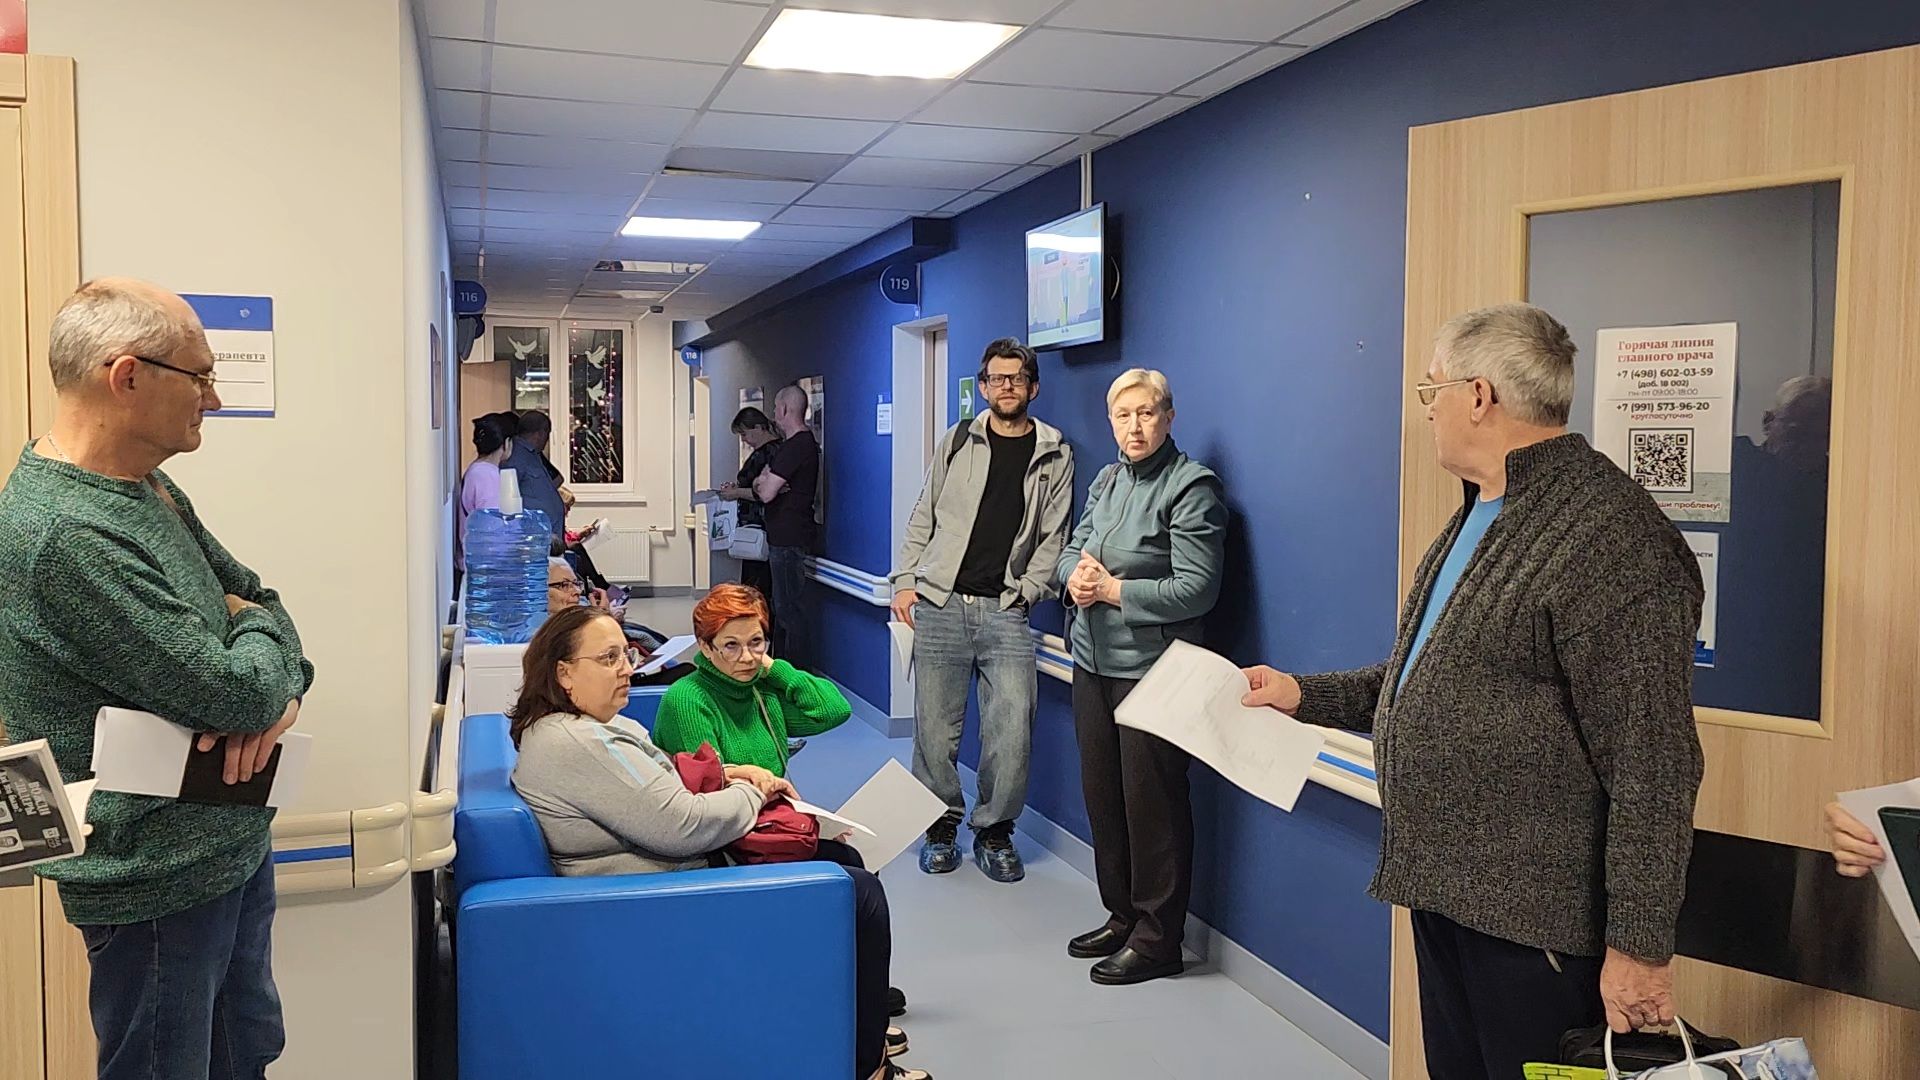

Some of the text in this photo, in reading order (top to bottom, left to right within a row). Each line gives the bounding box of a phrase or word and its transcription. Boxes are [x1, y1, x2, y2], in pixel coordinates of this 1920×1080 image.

[890, 277, 910, 291] 119
[460, 292, 478, 302] 116
[1618, 339, 1714, 352] Горячая линия
[1617, 351, 1714, 363] главного врача
[1617, 367, 1714, 379] +7 (498) 602-03-59
[1638, 380, 1658, 389] (доб.
[1670, 380, 1690, 388] 002)
[1617, 402, 1710, 413] +7 (991) 573-96-20
[1631, 412, 1694, 421] круглосуточно
[1674, 501, 1721, 509] проблему!
